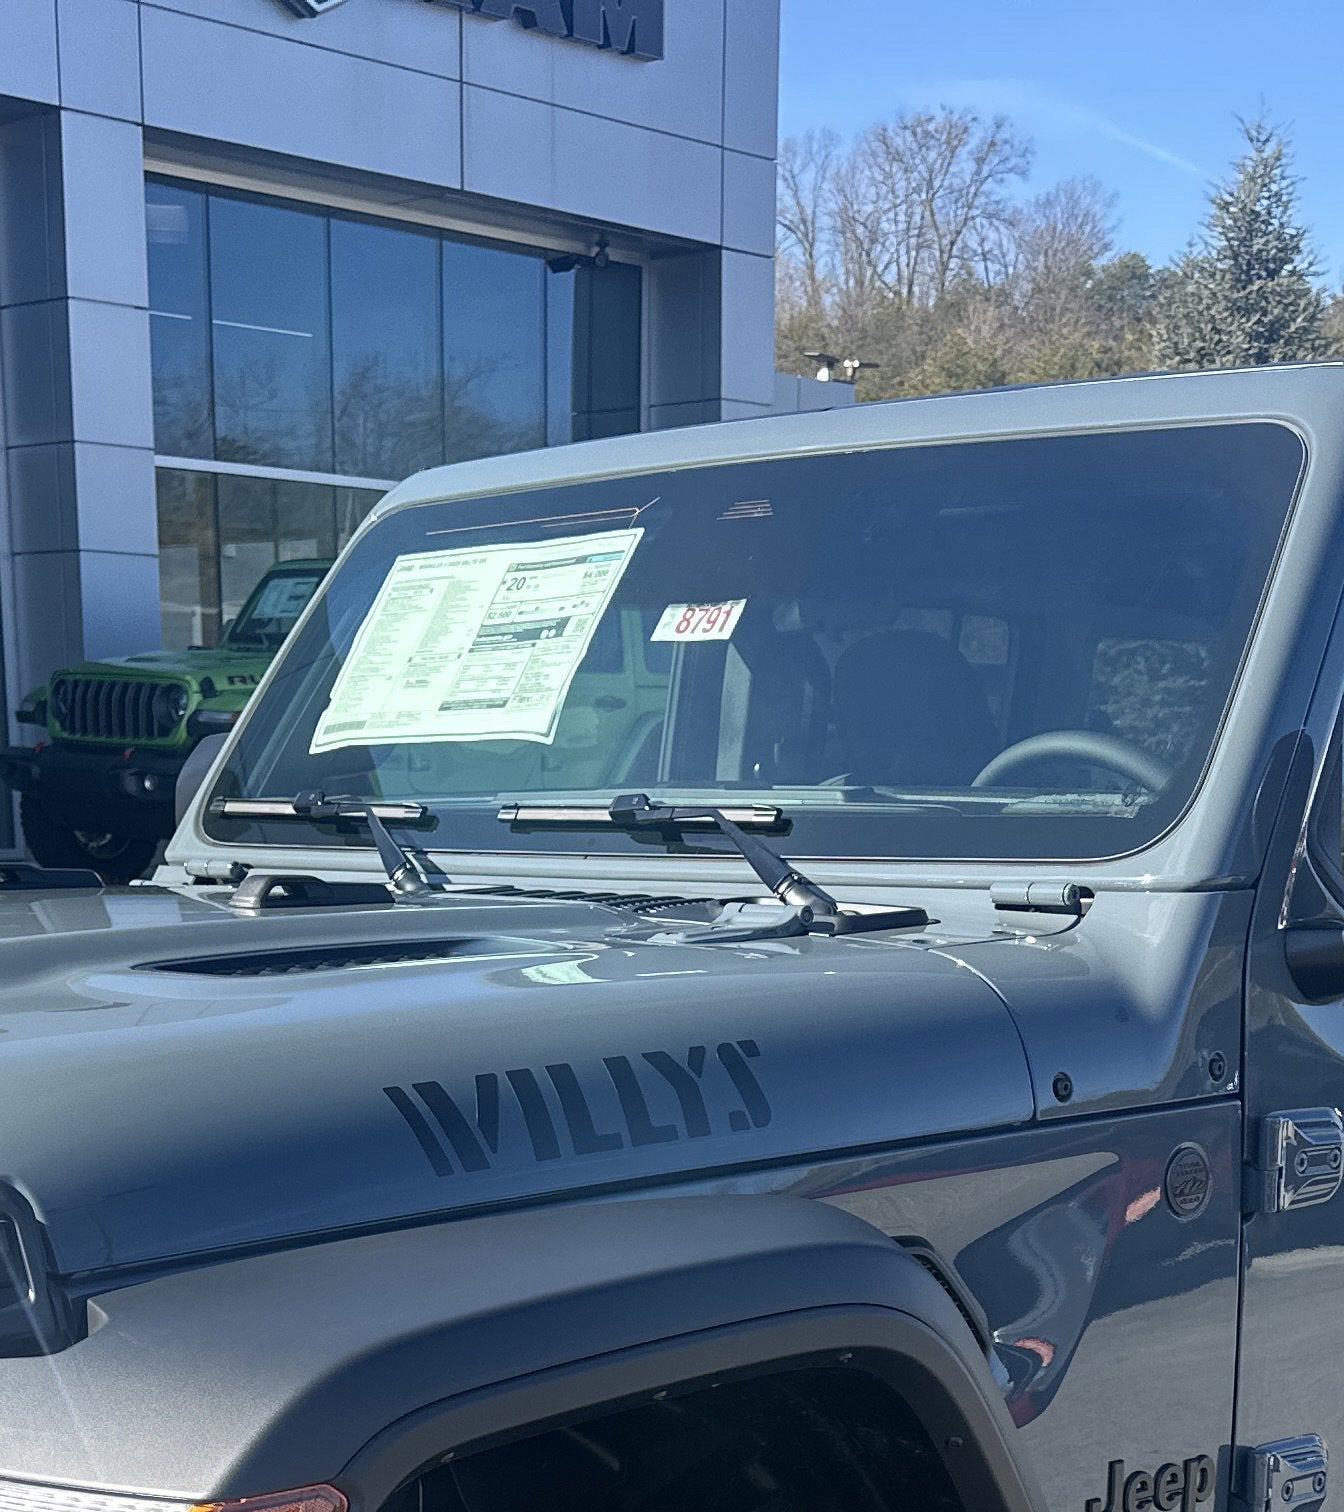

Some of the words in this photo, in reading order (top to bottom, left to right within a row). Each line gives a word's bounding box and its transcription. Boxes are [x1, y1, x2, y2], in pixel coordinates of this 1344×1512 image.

[506, 577, 526, 591] 20
[675, 605, 735, 634] 8791
[382, 1038, 773, 1178] WILLYS
